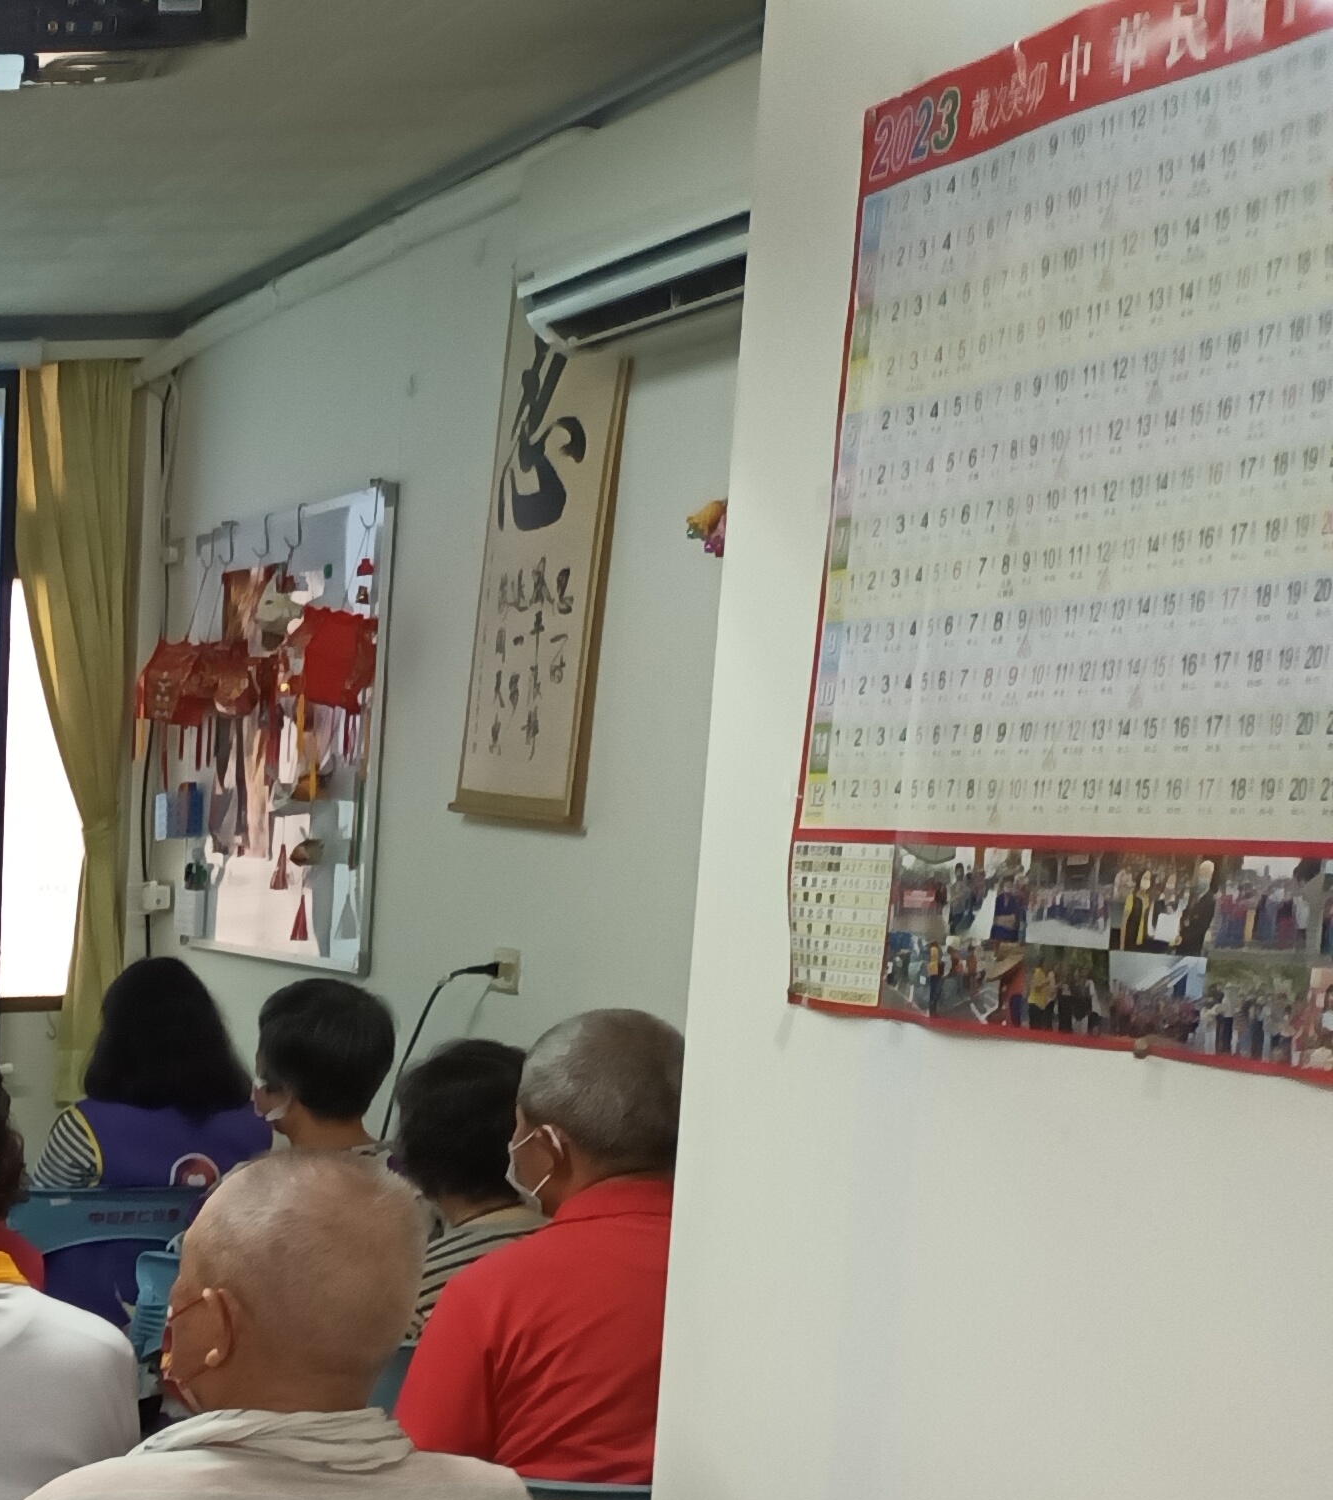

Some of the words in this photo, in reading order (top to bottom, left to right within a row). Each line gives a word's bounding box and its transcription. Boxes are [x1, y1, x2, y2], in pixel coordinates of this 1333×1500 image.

[869, 87, 961, 181] 2023
[1180, 281, 1193, 301] 14
[881, 410, 890, 431] 2
[906, 406, 914, 425] 3
[929, 400, 939, 419] 4
[1033, 376, 1042, 397] 9
[877, 465, 886, 485] 2
[968, 448, 977, 468] 6
[1030, 434, 1038, 456] 9
[896, 514, 905, 534] 3
[919, 510, 929, 529] 4
[961, 504, 970, 524] 6
[1156, 472, 1168, 491] 14
[1273, 451, 1289, 475] 18
[891, 568, 900, 587] 3
[914, 565, 923, 583] 4
[979, 557, 987, 574] 7
[1002, 554, 1010, 575] 8
[1023, 551, 1030, 572] 9
[1148, 536, 1159, 553] 14
[1199, 526, 1215, 549] 16
[1231, 522, 1248, 544] 17
[1265, 518, 1280, 542] 18
[909, 619, 917, 637] 4
[944, 616, 953, 635] 6
[970, 613, 978, 631] 7
[994, 611, 1003, 631] 8
[1138, 597, 1150, 614] 14
[1256, 584, 1272, 607] 18
[1287, 581, 1302, 605] 19
[1313, 578, 1333, 603] 20
[859, 676, 867, 695] 2
[882, 675, 890, 694] 3
[904, 672, 913, 691] 4
[938, 670, 946, 690] 6
[1182, 653, 1198, 676] 16
[1214, 651, 1231, 671] 17
[1247, 649, 1264, 672] 18
[854, 727, 863, 747] 2
[898, 725, 908, 743] 4
[933, 724, 940, 744] 6
[953, 723, 961, 741] 7
[973, 723, 982, 743] 8
[997, 722, 1007, 742] 9
[1118, 719, 1131, 736] 14
[1174, 716, 1190, 738] 16
[1206, 714, 1223, 735] 17
[831, 780, 837, 794] 1
[850, 779, 859, 798] 2
[893, 778, 902, 795] 4
[928, 779, 935, 798] 6
[967, 779, 974, 799] 8
[1109, 779, 1122, 796] 14
[1135, 778, 1150, 799] 15
[1231, 778, 1246, 800] 18
[1261, 778, 1275, 800] 19
